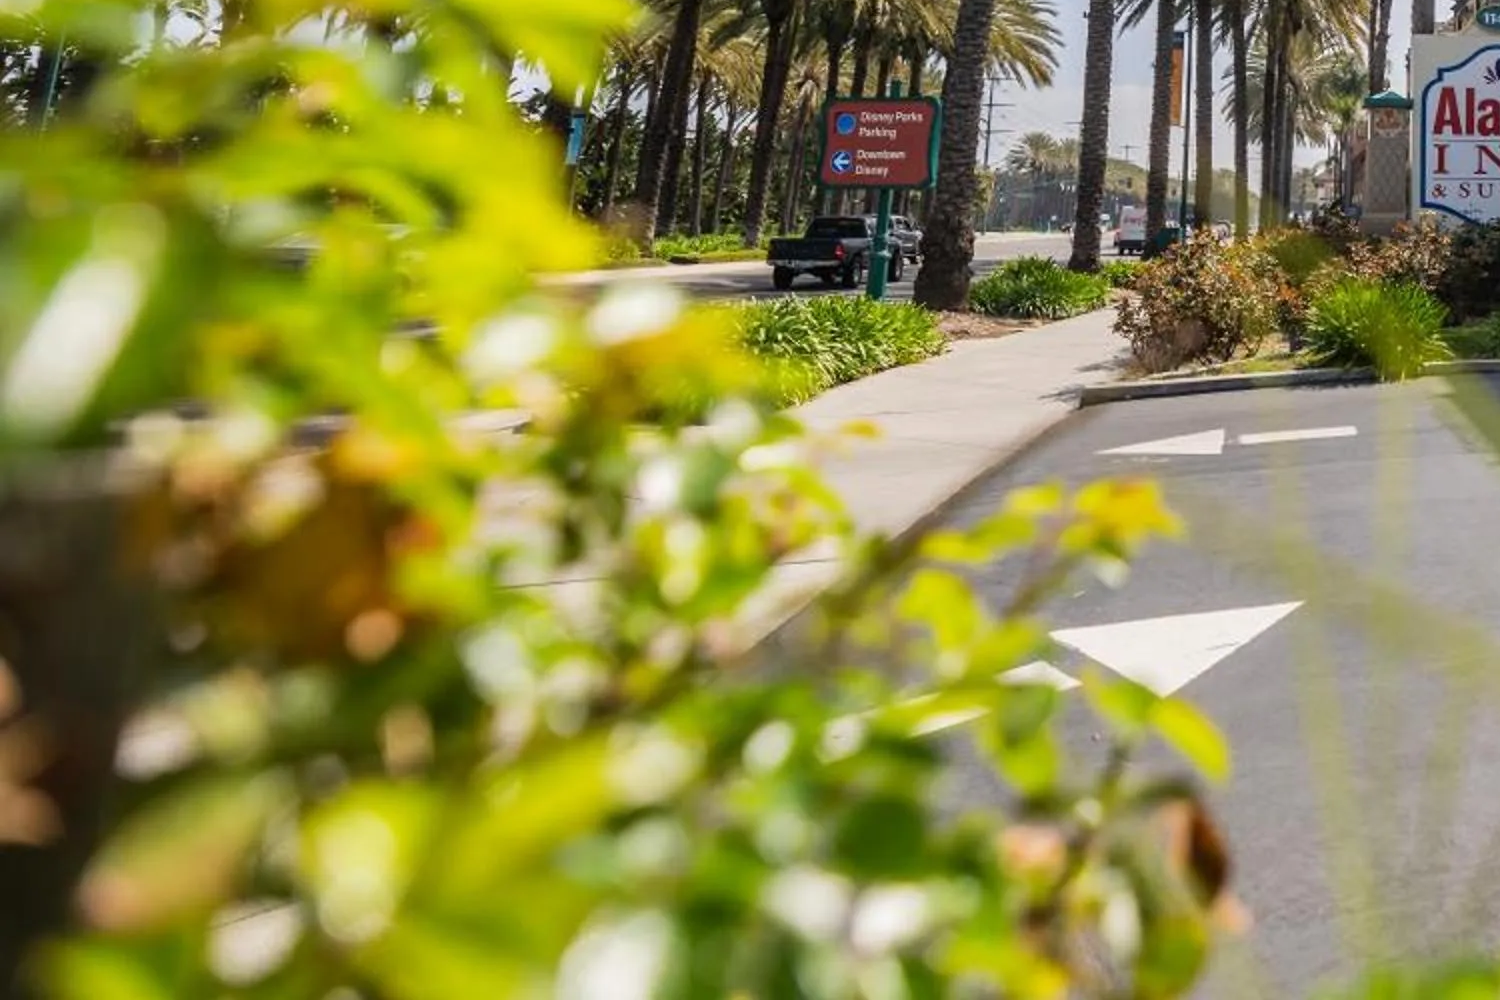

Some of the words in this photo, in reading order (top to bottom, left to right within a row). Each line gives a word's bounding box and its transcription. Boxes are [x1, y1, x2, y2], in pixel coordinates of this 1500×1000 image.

[896, 111, 923, 122] Parks
[858, 126, 897, 140] Parking
[856, 149, 906, 160] Downtown
[1431, 183, 1448, 199] &
